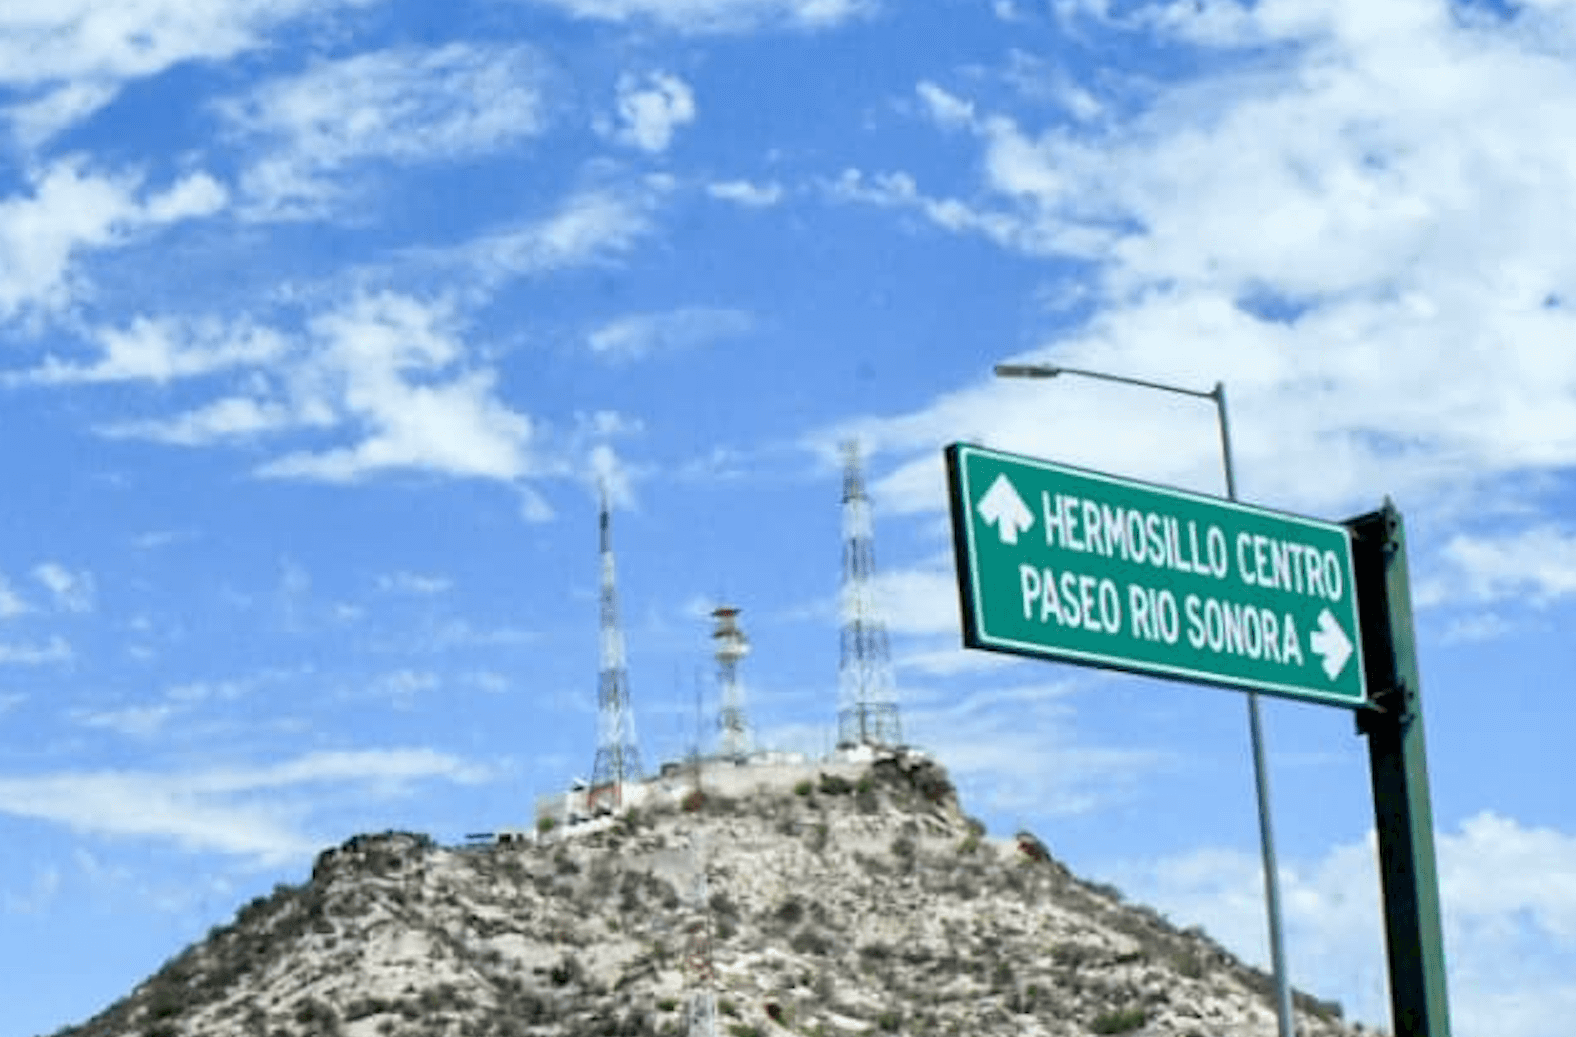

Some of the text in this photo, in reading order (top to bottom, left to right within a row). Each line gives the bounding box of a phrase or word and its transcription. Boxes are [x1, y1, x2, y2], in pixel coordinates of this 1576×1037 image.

[1042, 490, 1343, 601] HERMOSILLO CENTRO
[1019, 564, 1304, 666] PASEO RIO SONORA
